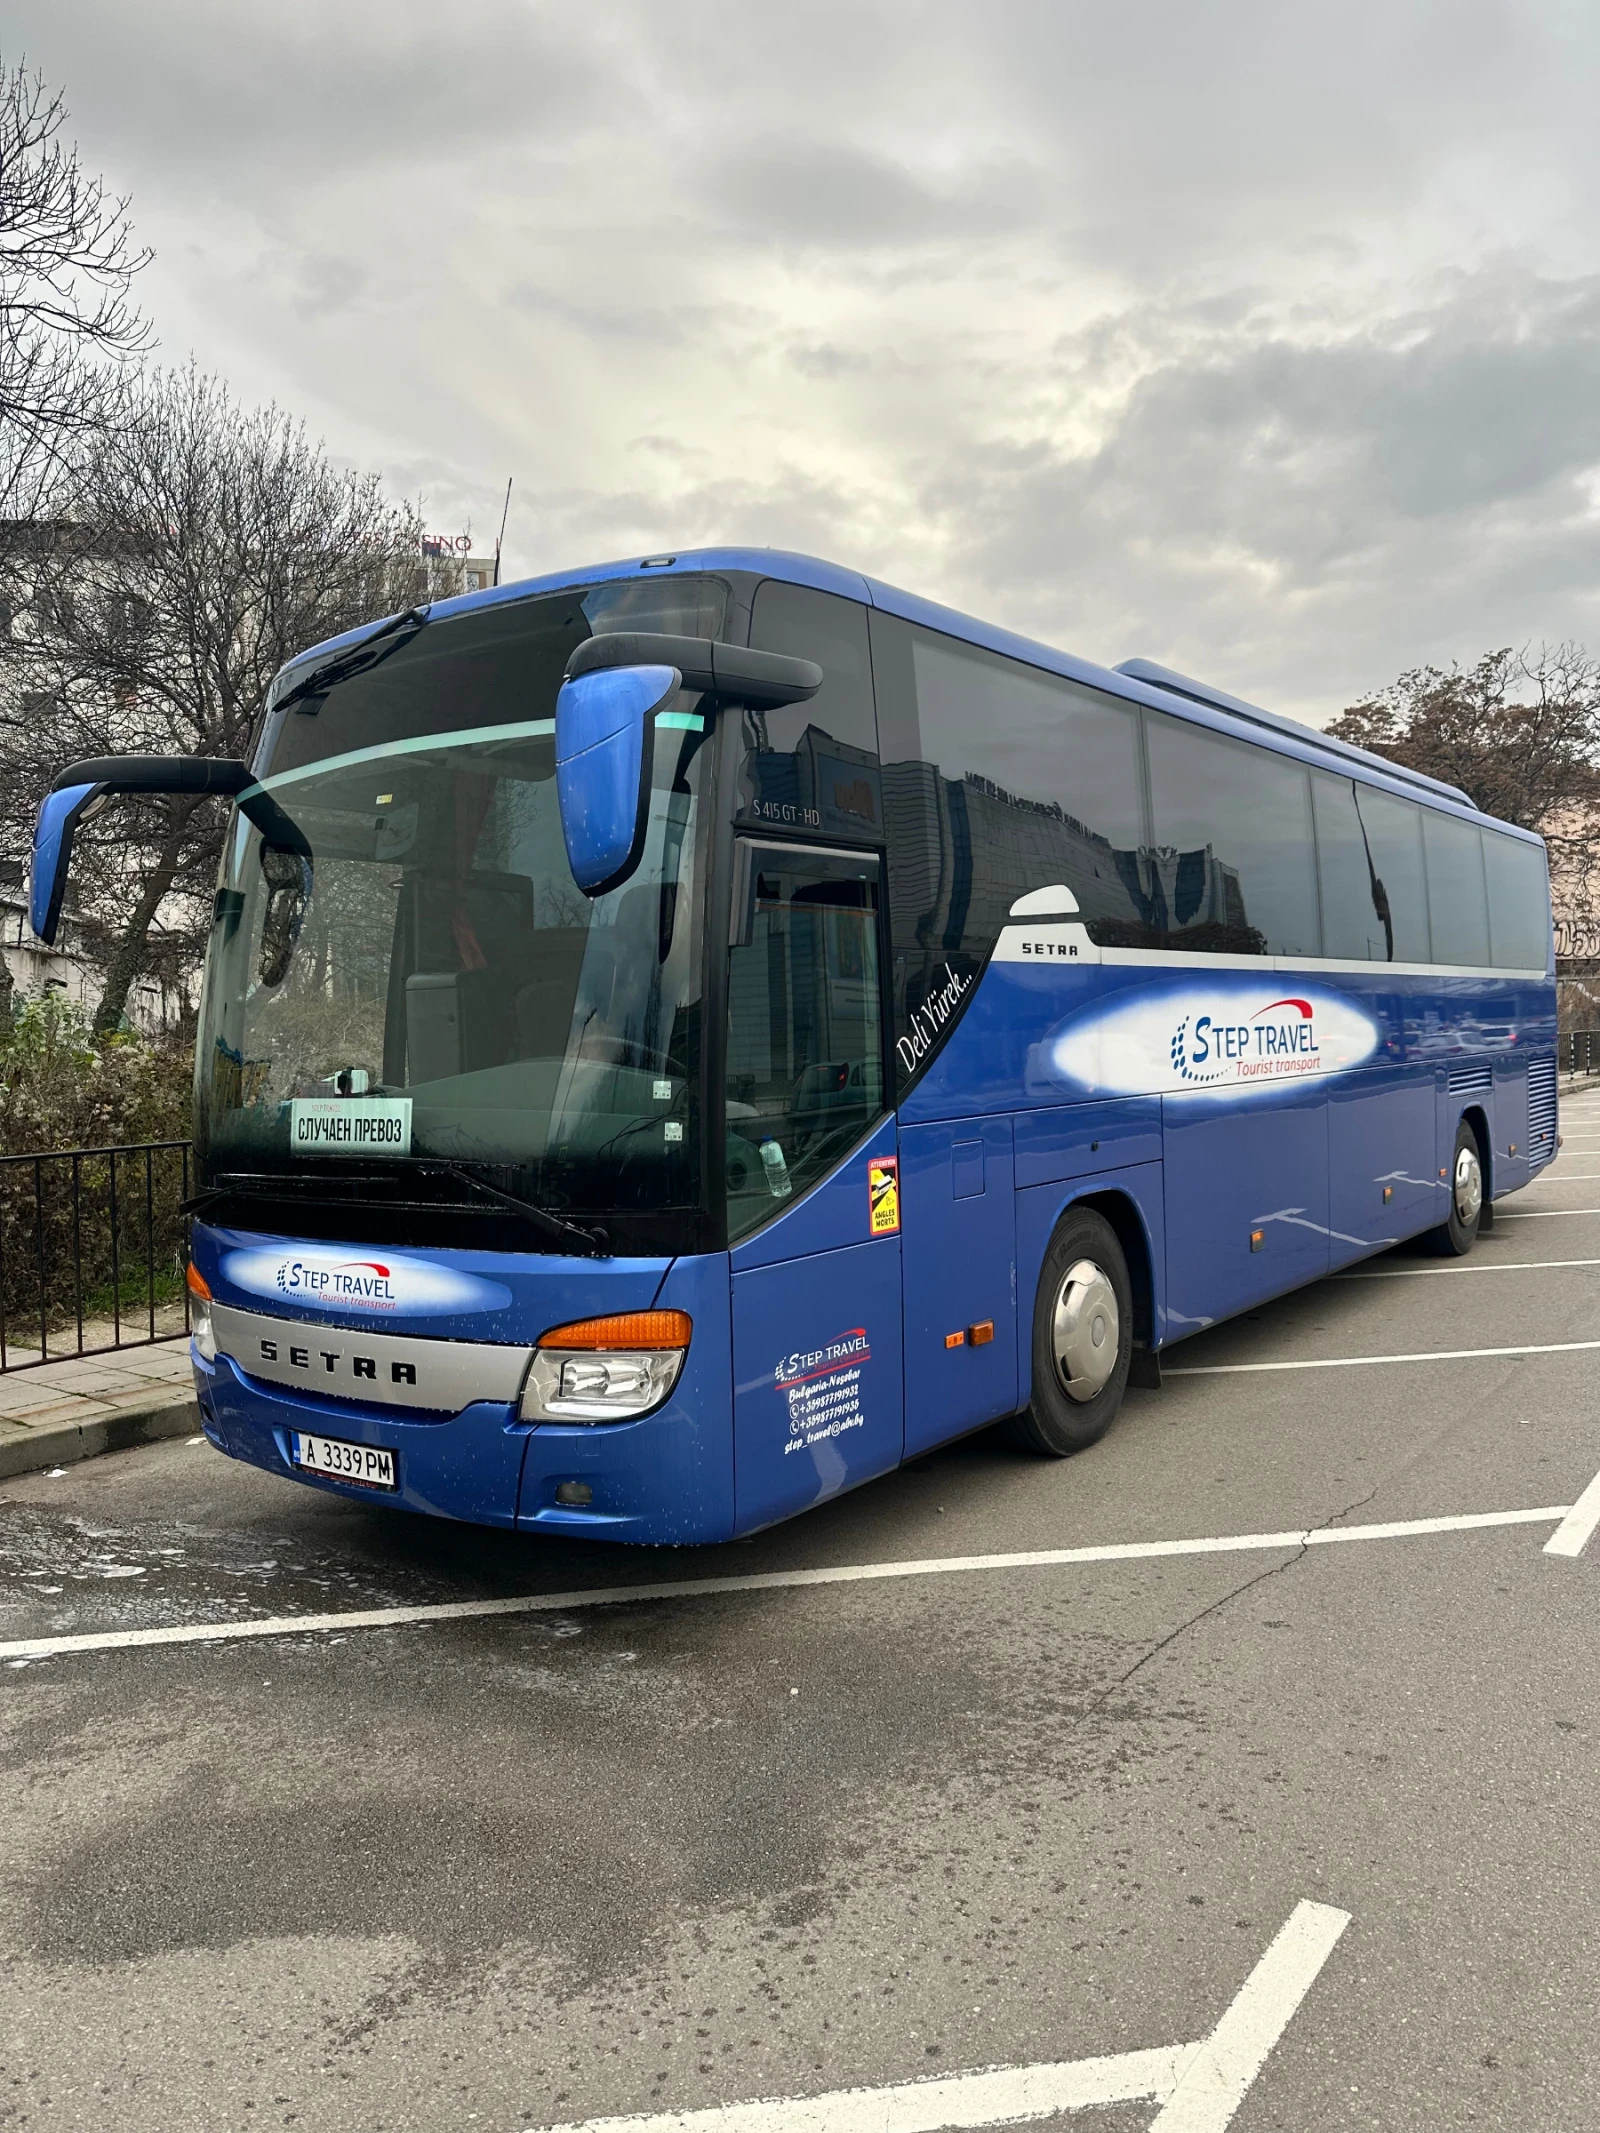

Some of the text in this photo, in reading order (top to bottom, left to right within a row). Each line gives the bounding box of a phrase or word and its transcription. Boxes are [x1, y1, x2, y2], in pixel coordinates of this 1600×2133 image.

[762, 802, 781, 819] 415
[1022, 942, 1079, 956] SETRA
[896, 1013, 932, 1074] Deli
[1254, 1024, 1319, 1056] TRAVEL
[1236, 1055, 1321, 1077] Tourist transport
[298, 1117, 403, 1143] СЛУЧАЕН ПРЕВОЗ
[870, 1157, 896, 1169] ATTENTION
[874, 1208, 896, 1220] ANGLES
[875, 1217, 896, 1228] MORTS
[333, 1274, 396, 1300] TRAVEL
[317, 1291, 396, 1311] Tourist transport
[826, 1337, 870, 1359] TRAVEL
[260, 1338, 417, 1386] SETRA
[307, 1438, 316, 1464] A
